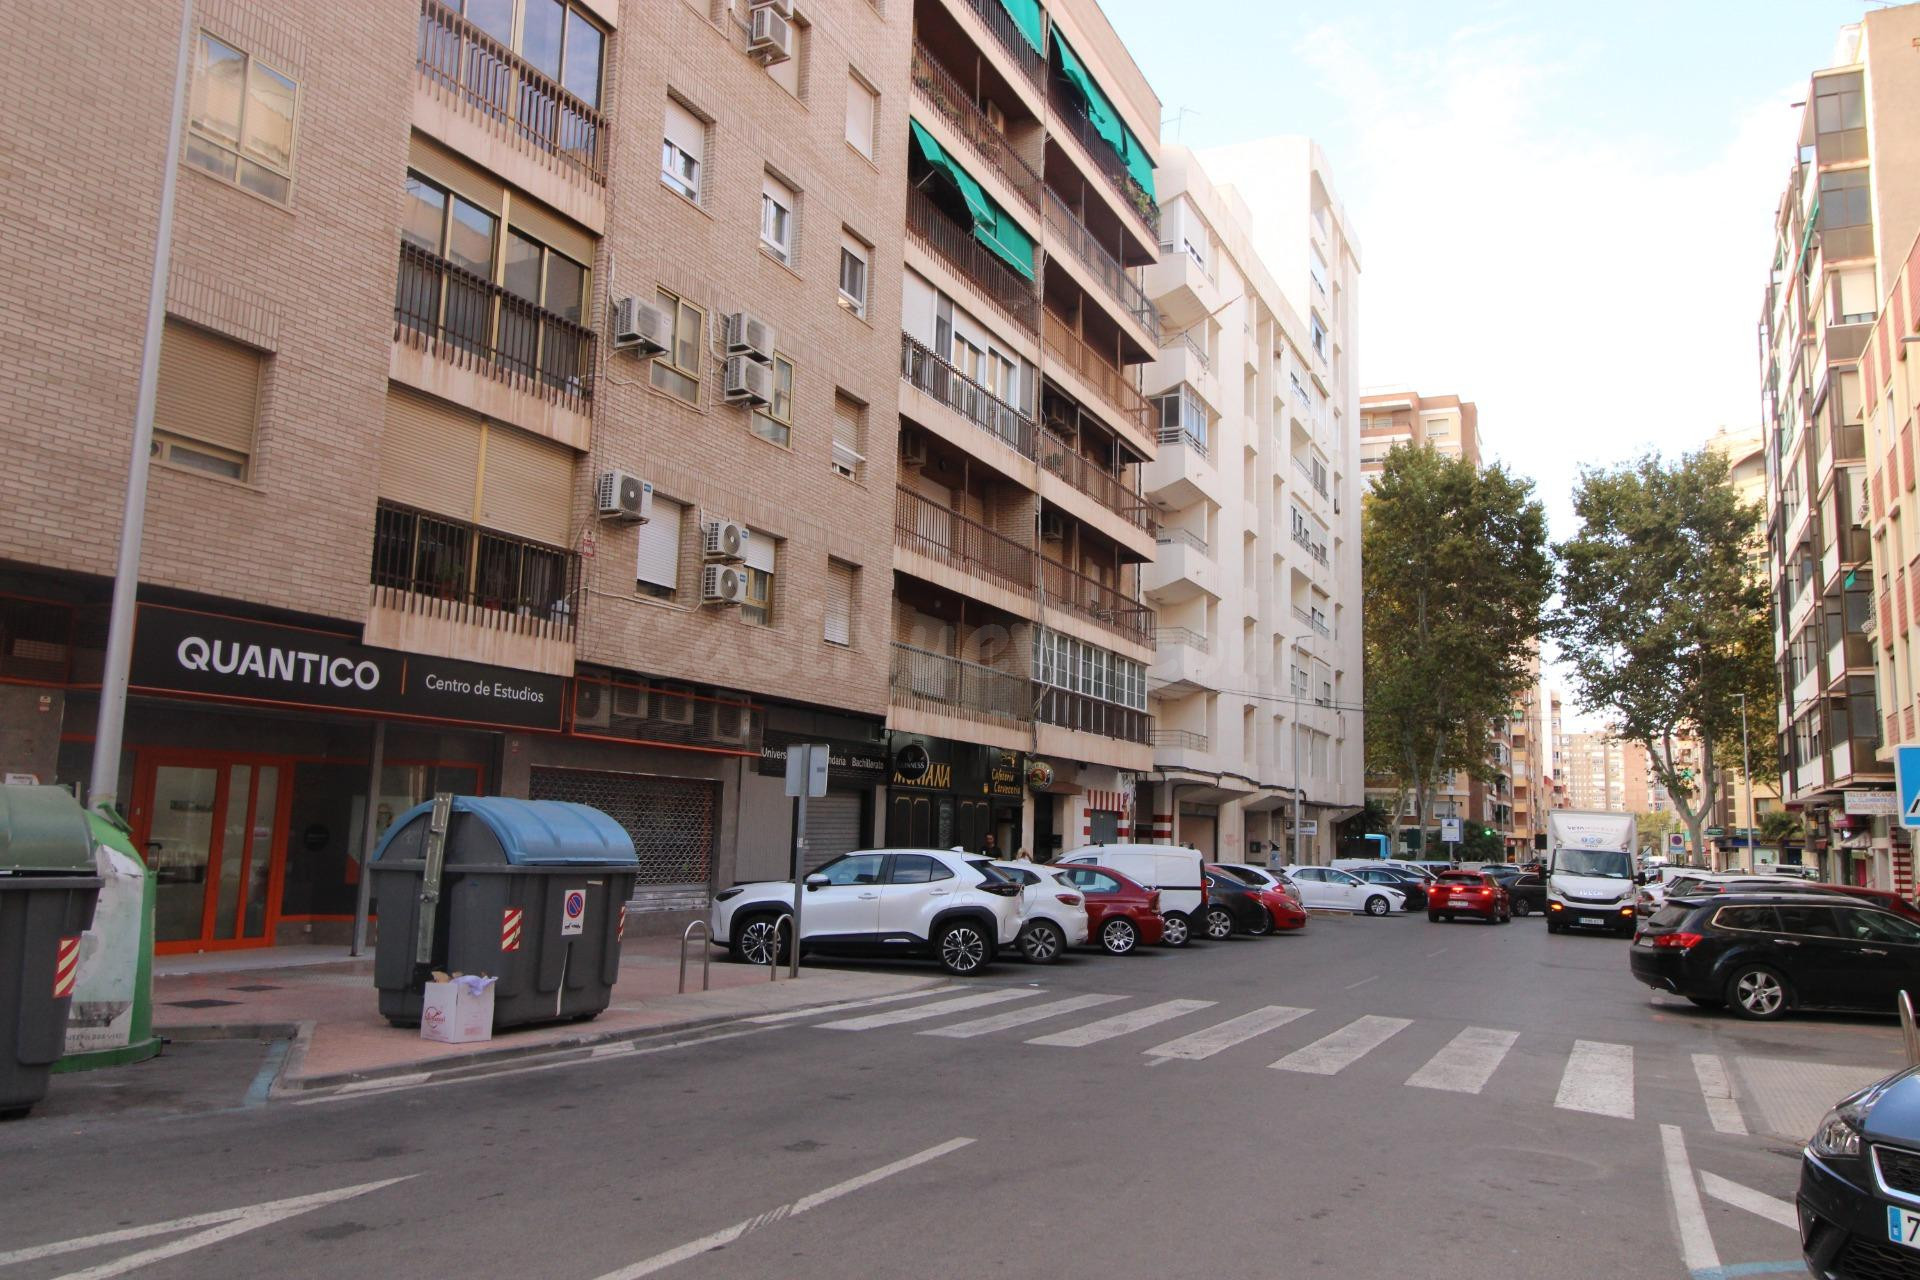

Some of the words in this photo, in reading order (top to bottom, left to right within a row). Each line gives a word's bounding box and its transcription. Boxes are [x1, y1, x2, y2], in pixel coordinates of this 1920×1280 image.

[177, 636, 380, 691] QUANTICO
[425, 674, 471, 693] Centro
[474, 680, 491, 696] de
[494, 683, 544, 703] Estudios
[761, 747, 788, 760] Univers
